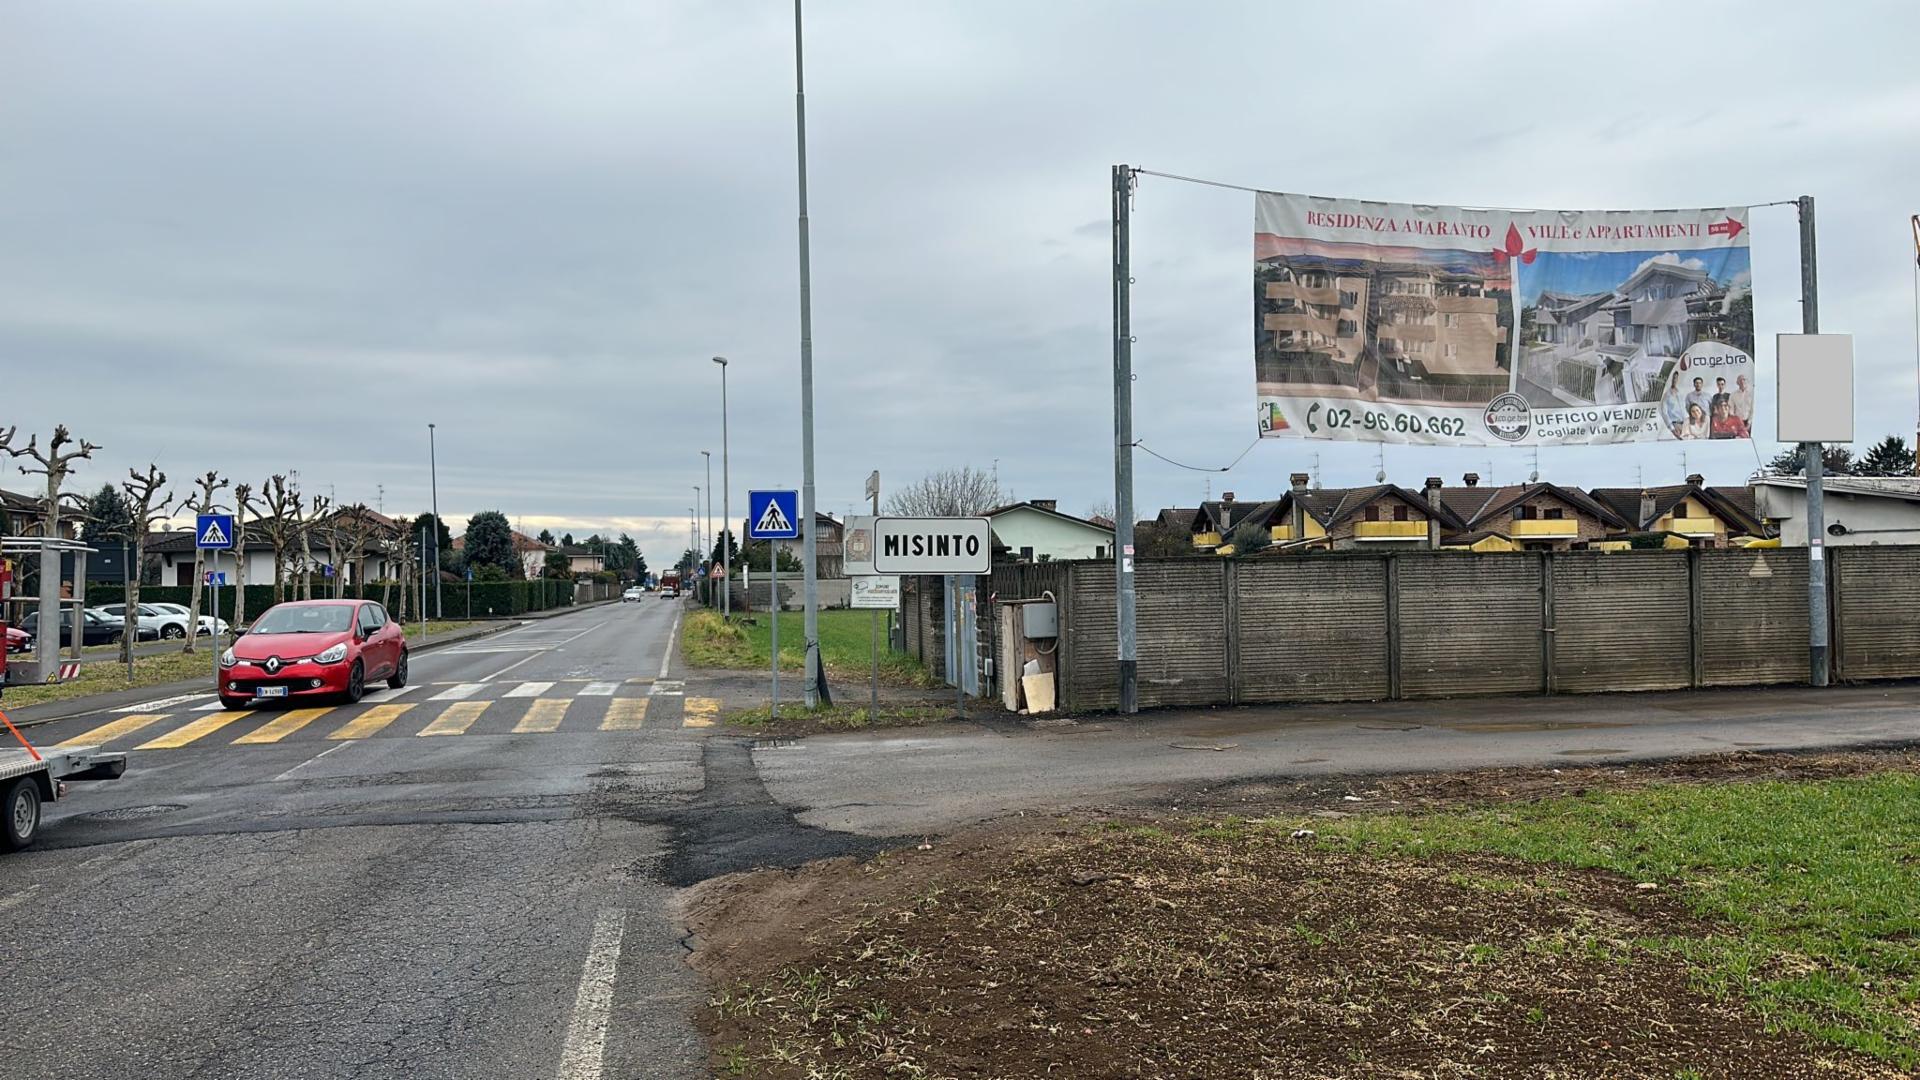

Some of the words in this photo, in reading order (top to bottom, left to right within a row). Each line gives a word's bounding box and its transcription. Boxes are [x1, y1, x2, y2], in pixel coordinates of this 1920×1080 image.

[1307, 210, 1397, 232] RESIDENZA
[1402, 219, 1491, 239] AMARANTO
[1528, 225, 1570, 240] VILLE
[1573, 229, 1581, 240] e
[1586, 223, 1700, 240] APPARTAMENTI
[1693, 353, 1747, 368] co.ge.bra
[1326, 408, 1466, 437] 02-96.60.662
[1534, 411, 1598, 425] UFFICIO
[1603, 407, 1657, 421] VENDITE
[1537, 426, 1586, 438] Cogliate
[1589, 425, 1608, 435] Via
[1646, 422, 1659, 431] 31
[884, 534, 980, 557] MISINTO
